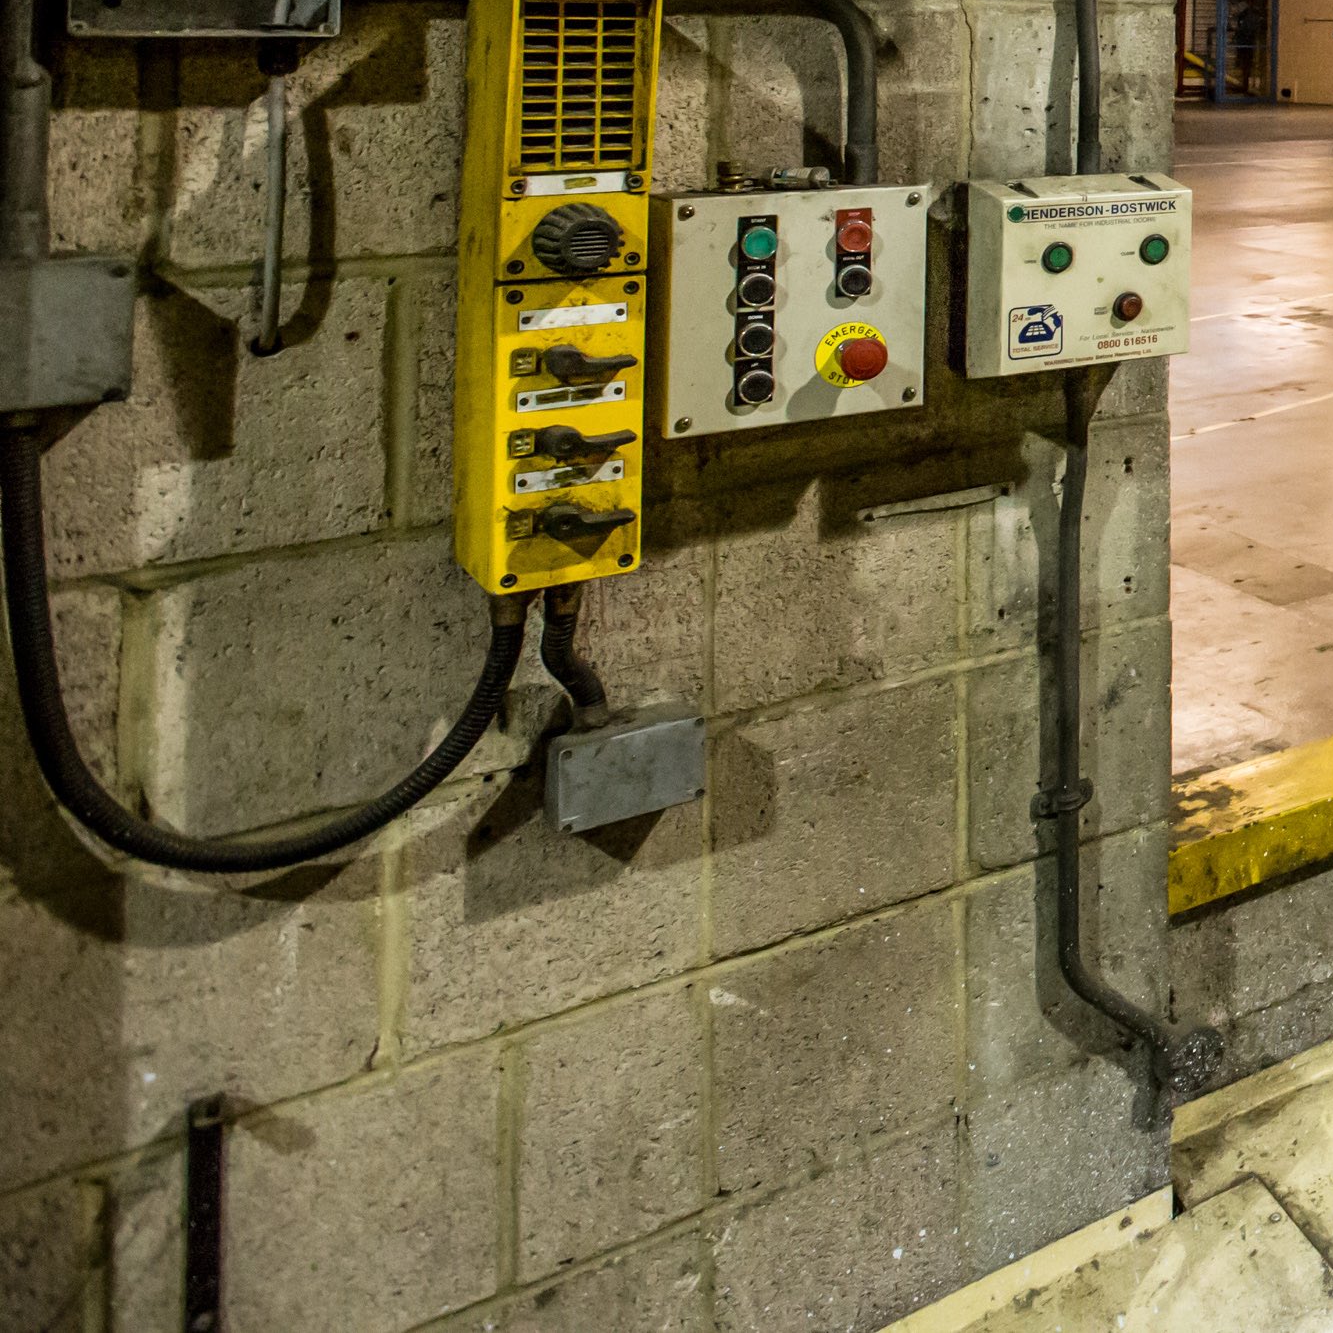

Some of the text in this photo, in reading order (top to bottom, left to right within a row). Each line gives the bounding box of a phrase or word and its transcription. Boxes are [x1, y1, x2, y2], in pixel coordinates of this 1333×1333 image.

[1024, 201, 1176, 221] HENDERSON-BOSTWICK
[1095, 218, 1131, 226] INDUSTRIAL
[1012, 313, 1024, 323] 24
[824, 325, 880, 347] EMERGEN
[1097, 334, 1158, 350] 0800 616516
[1033, 343, 1059, 351] SERVICE
